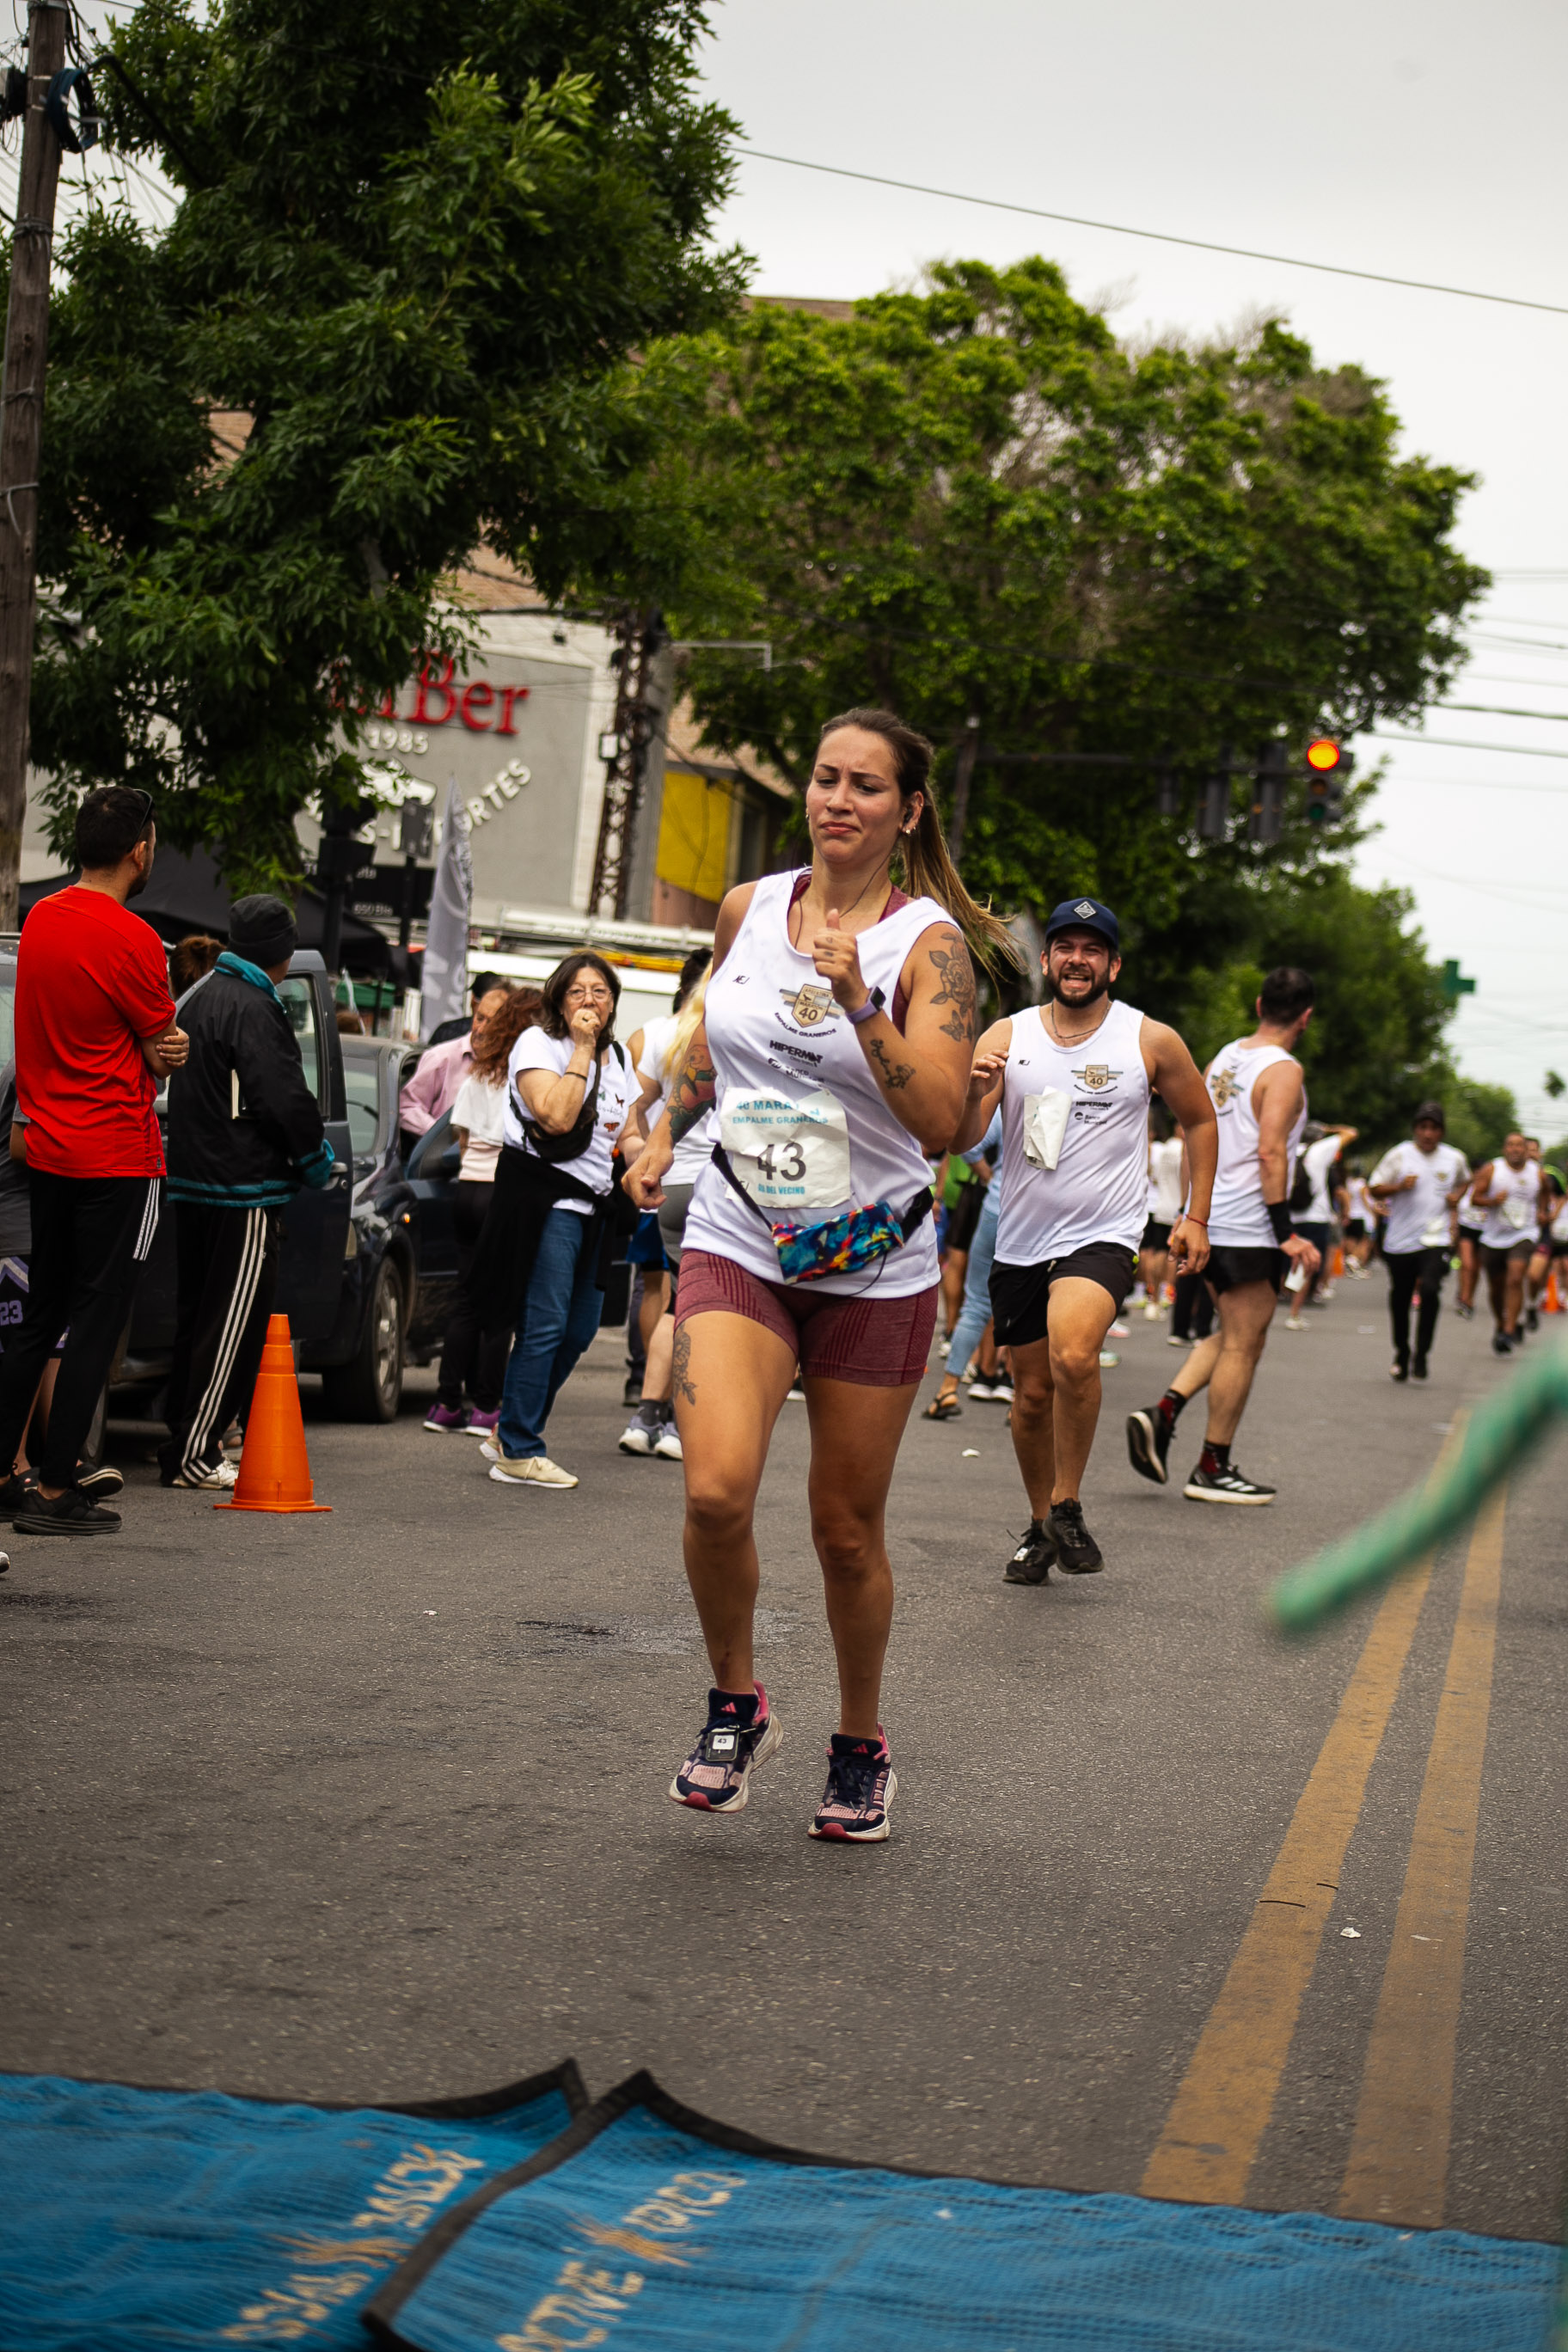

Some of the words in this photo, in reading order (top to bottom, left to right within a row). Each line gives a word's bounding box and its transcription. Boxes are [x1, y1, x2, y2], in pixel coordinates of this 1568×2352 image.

[367, 726, 429, 755] 1985
[775, 1012, 798, 1034] EMPALME
[799, 1008, 818, 1021] 40
[1089, 1077, 1104, 1086] 40
[757, 1142, 806, 1181] 43
[778, 1185, 805, 1195] VECINO
[0, 1300, 23, 1326] 23
